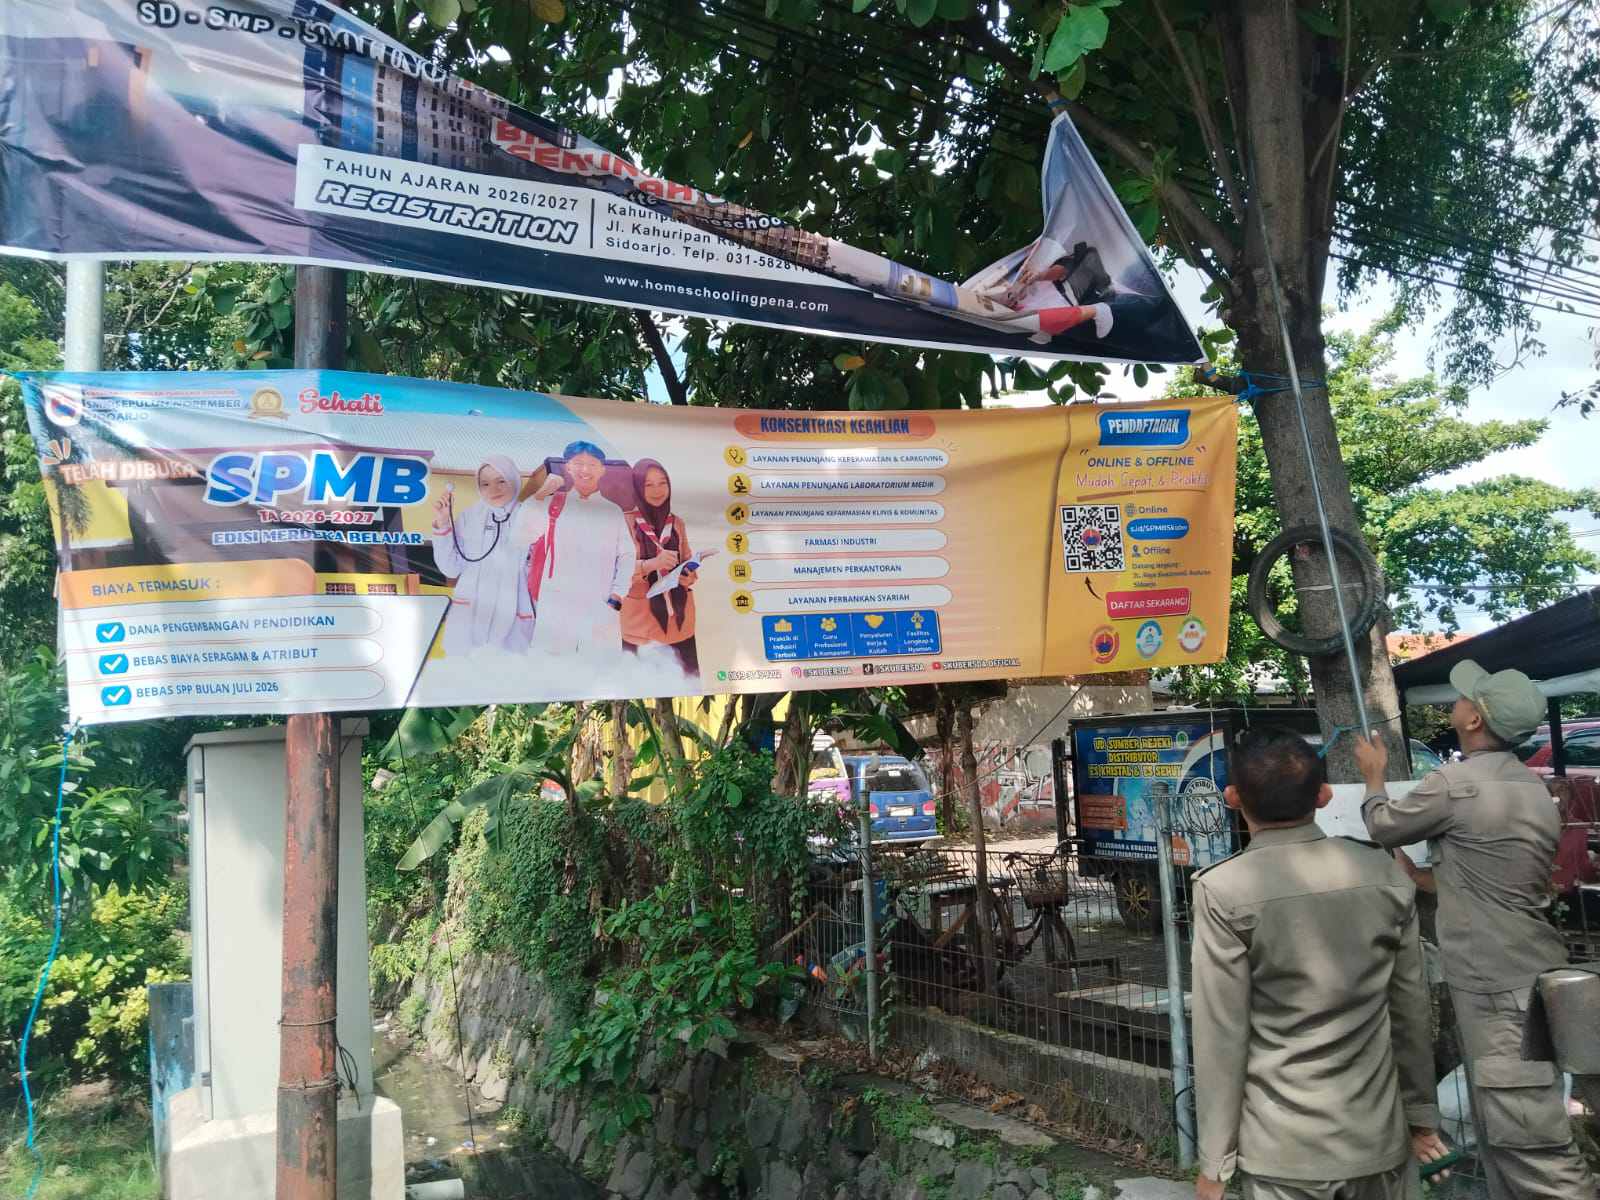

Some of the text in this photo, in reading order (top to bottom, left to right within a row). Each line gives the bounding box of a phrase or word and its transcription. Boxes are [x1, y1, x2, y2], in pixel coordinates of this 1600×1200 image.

[139, 1, 178, 27] SD
[205, 8, 272, 34] SMP
[323, 157, 392, 182] TAHUN
[400, 171, 480, 196] AJARAN
[487, 186, 579, 212] 2026/2027
[315, 179, 578, 245] REGISTRATION
[606, 220, 625, 234] Jl.
[631, 223, 711, 245] Kahuripan
[606, 236, 676, 257] Sidoarjo.
[684, 246, 720, 263] Telp.
[604, 273, 830, 313] www.homeschoolingpena.com
[299, 386, 384, 414] Sehati
[760, 415, 910, 434] KONSENTRASI KEAHLIAN
[1106, 418, 1180, 434] PENDAFTARAN
[752, 455, 790, 463] LAYANAN
[791, 455, 836, 465] PENUNJANG
[1087, 456, 1195, 468] ONLINE & OFFLINE
[58, 458, 198, 485] TELAH DIBUKA
[203, 450, 434, 506] SPMB
[760, 481, 800, 490] LAYANAN
[801, 481, 849, 491] PENUNJANG
[850, 481, 910, 490] LABORATORIUM
[258, 509, 375, 525] TA 2026-2027
[1138, 505, 1168, 514] Online
[212, 529, 423, 546] EDISI MERDEKA BELAJAR
[804, 537, 877, 547] FARMASI INDUSTRI
[793, 564, 902, 576] MANAJEMEN PERKANTORAN
[92, 581, 136, 597] BIAYA
[138, 578, 210, 595] TERMASUK
[788, 596, 826, 605] LAYANAN
[877, 593, 910, 602] SYARIAH
[1110, 600, 1145, 610] DAFTAR
[129, 615, 335, 636] DANA PENGEMBANGAN PENDIDIKAN
[133, 647, 319, 667] BEBAS BIAYA SERAGAM & ATRIBUT
[136, 680, 279, 697] BEBAS SPP BULAN JULI 2026
[1109, 751, 1158, 763] DISTRIBUTOR
